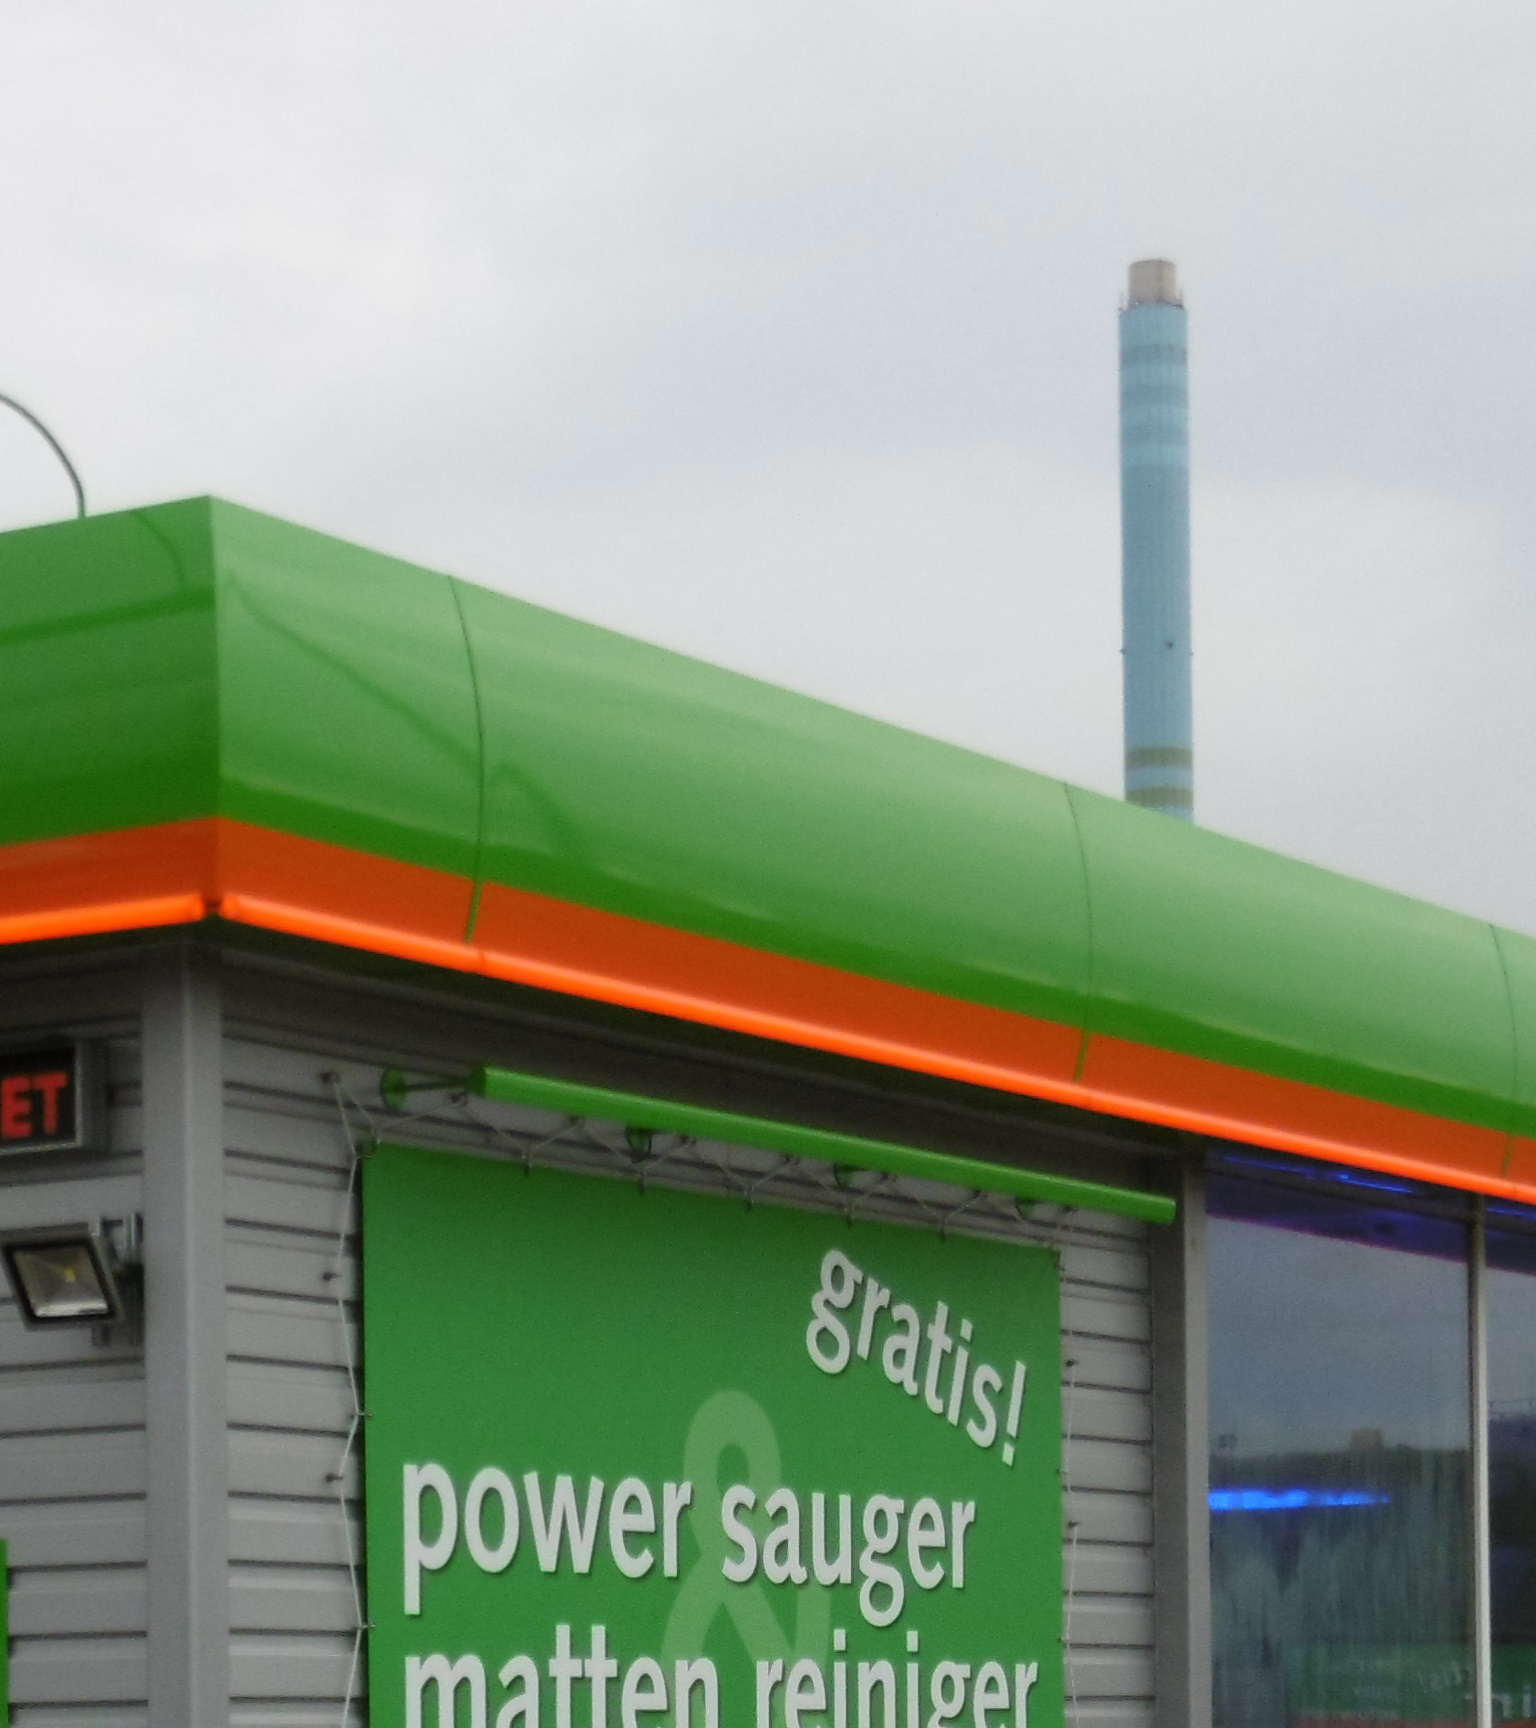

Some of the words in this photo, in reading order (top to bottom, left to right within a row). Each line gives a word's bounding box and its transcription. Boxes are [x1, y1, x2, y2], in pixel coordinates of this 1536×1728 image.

[806, 1248, 1027, 1466] gratis!
[402, 1459, 691, 1615] power
[722, 1481, 975, 1627] sauger
